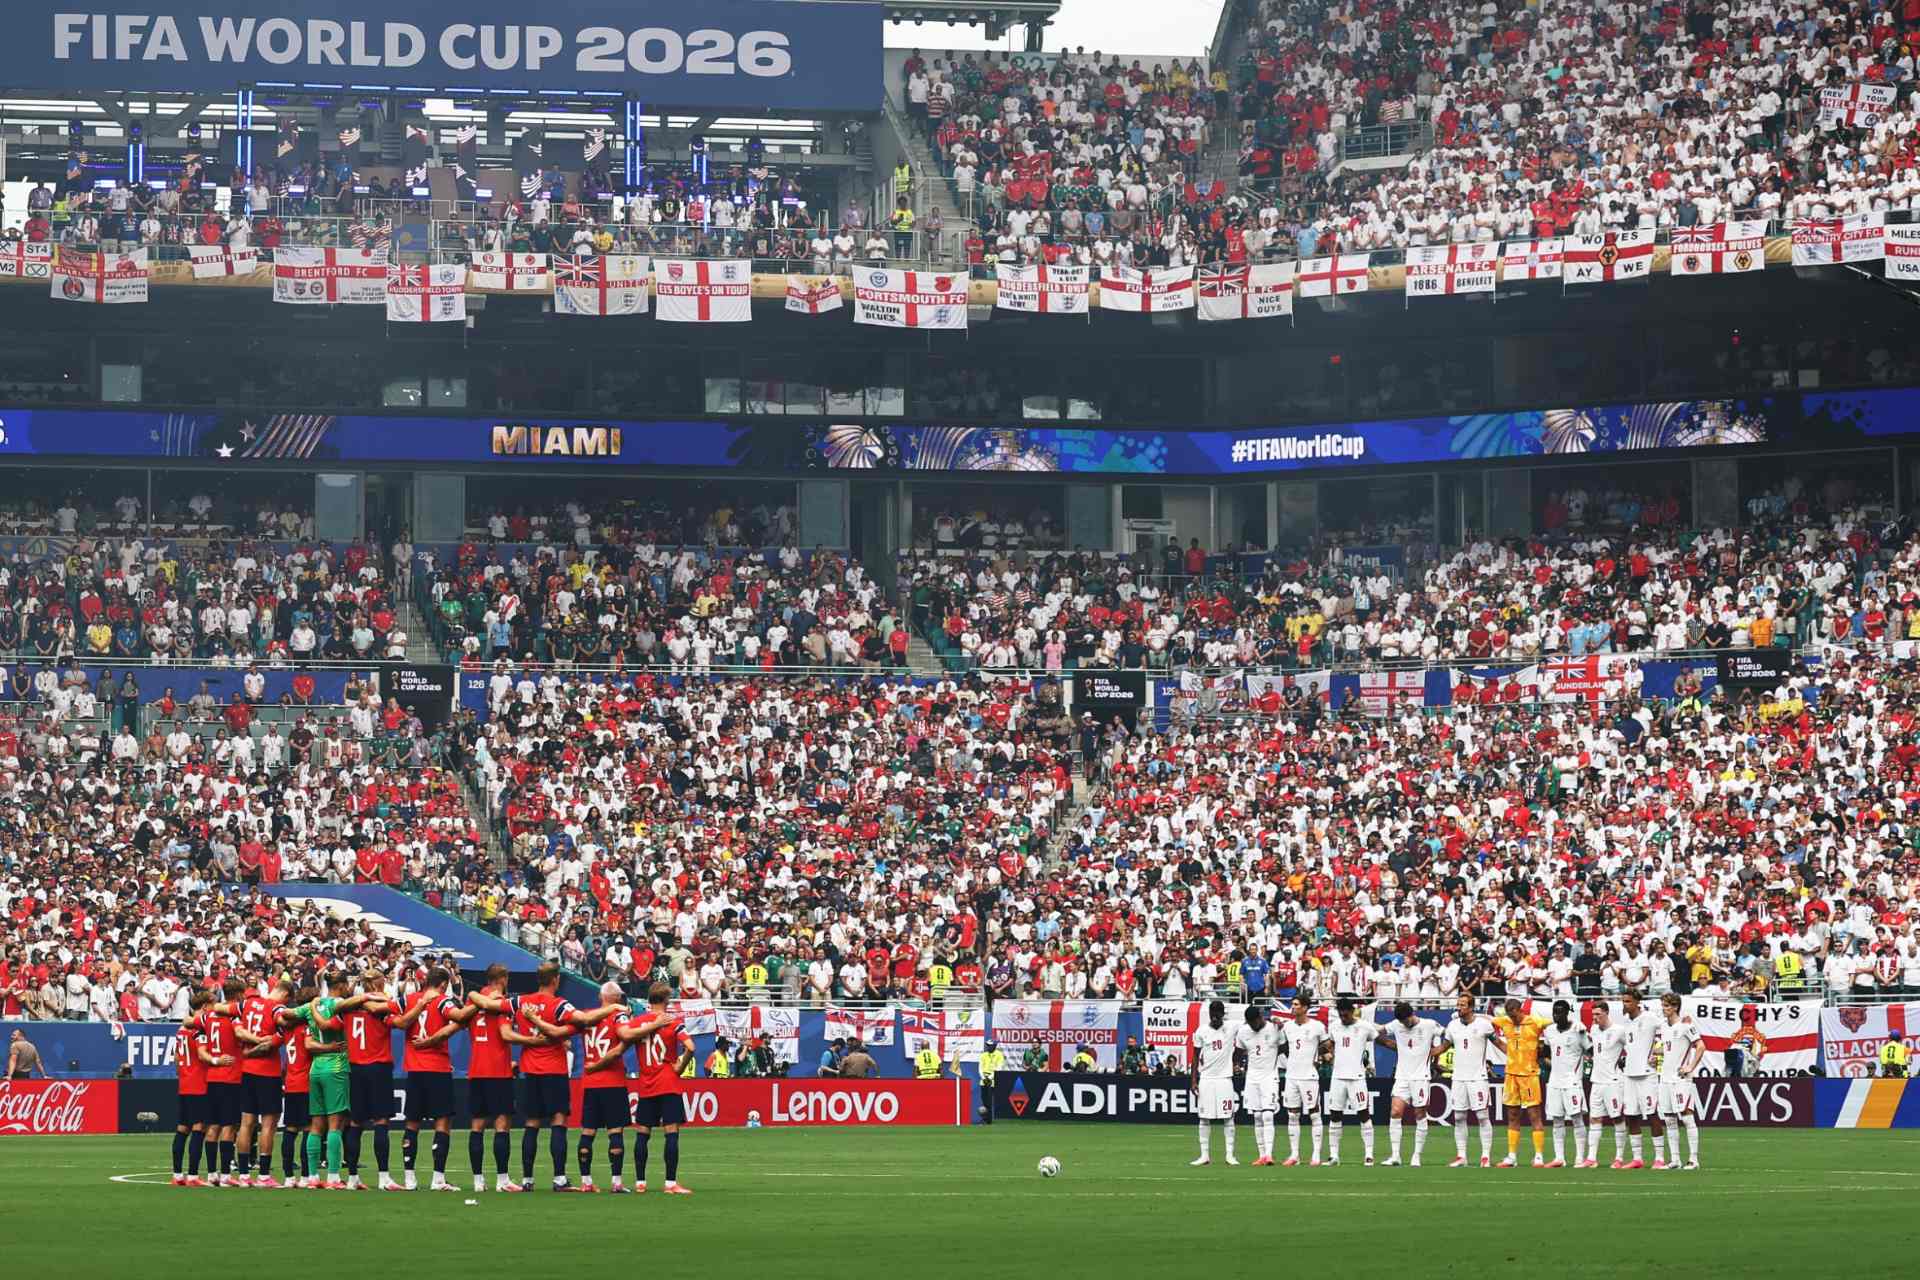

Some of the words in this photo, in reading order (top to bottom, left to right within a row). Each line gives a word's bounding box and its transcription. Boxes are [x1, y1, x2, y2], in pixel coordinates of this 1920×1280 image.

[54, 14, 188, 61] FIFA
[198, 17, 426, 68] WORLD
[439, 23, 563, 71] CUP
[575, 26, 792, 77] 2026
[1582, 232, 1638, 245] WOVES
[1844, 228, 1864, 240] CITY
[26, 244, 48, 254] ST4
[1728, 239, 1761, 251] WOLVES
[294, 267, 350, 279] BRENTFORD
[356, 267, 368, 277] FC
[1412, 263, 1470, 275] ARSENAL
[1474, 262, 1490, 271] FC
[1576, 266, 1593, 277] AY
[1623, 261, 1643, 273] WE
[1898, 264, 1919, 273] USA
[561, 279, 596, 288] LEEDS
[1125, 284, 1169, 293] FULHAM
[1413, 279, 1438, 291] 1886
[674, 285, 710, 295] BOYLE'S
[711, 285, 725, 295] ON
[725, 285, 748, 295] TOUR
[858, 288, 946, 304] PORTSMOUTH
[950, 294, 965, 304] FC
[1259, 295, 1281, 304] NICE
[861, 302, 900, 315] WALTON
[1257, 305, 1283, 313] GUYS
[865, 312, 896, 322] BLUES
[492, 427, 622, 456] MIAMI
[1231, 433, 1365, 463] #FIFAWorldCup
[1152, 1005, 1176, 1015] Our
[1697, 1004, 1800, 1022] BEECHY'S
[1147, 1017, 1181, 1027] Mate
[211, 1022, 221, 1053] 5
[352, 1016, 366, 1050] 9
[996, 1029, 1113, 1043] MIDDLESBROUGH
[1146, 1032, 1188, 1045] Jimmy
[1628, 1032, 1634, 1043] 3
[1212, 1039, 1223, 1051] 20
[1295, 1039, 1301, 1049] 5
[1342, 1036, 1351, 1048] 10
[1407, 1039, 1413, 1049] 4
[128, 1036, 177, 1066] FIFA
[286, 1034, 297, 1065] 6
[641, 1034, 667, 1067] 10
[1256, 1045, 1261, 1056] 2
[1036, 1082, 1116, 1116] ADI
[1307, 1090, 1313, 1102] 5
[1356, 1092, 1366, 1102] 10
[1419, 1088, 1425, 1099] 4
[1477, 1091, 1484, 1101] 9
[772, 1083, 899, 1122] Lenovo
[1222, 1100, 1233, 1111] 20
